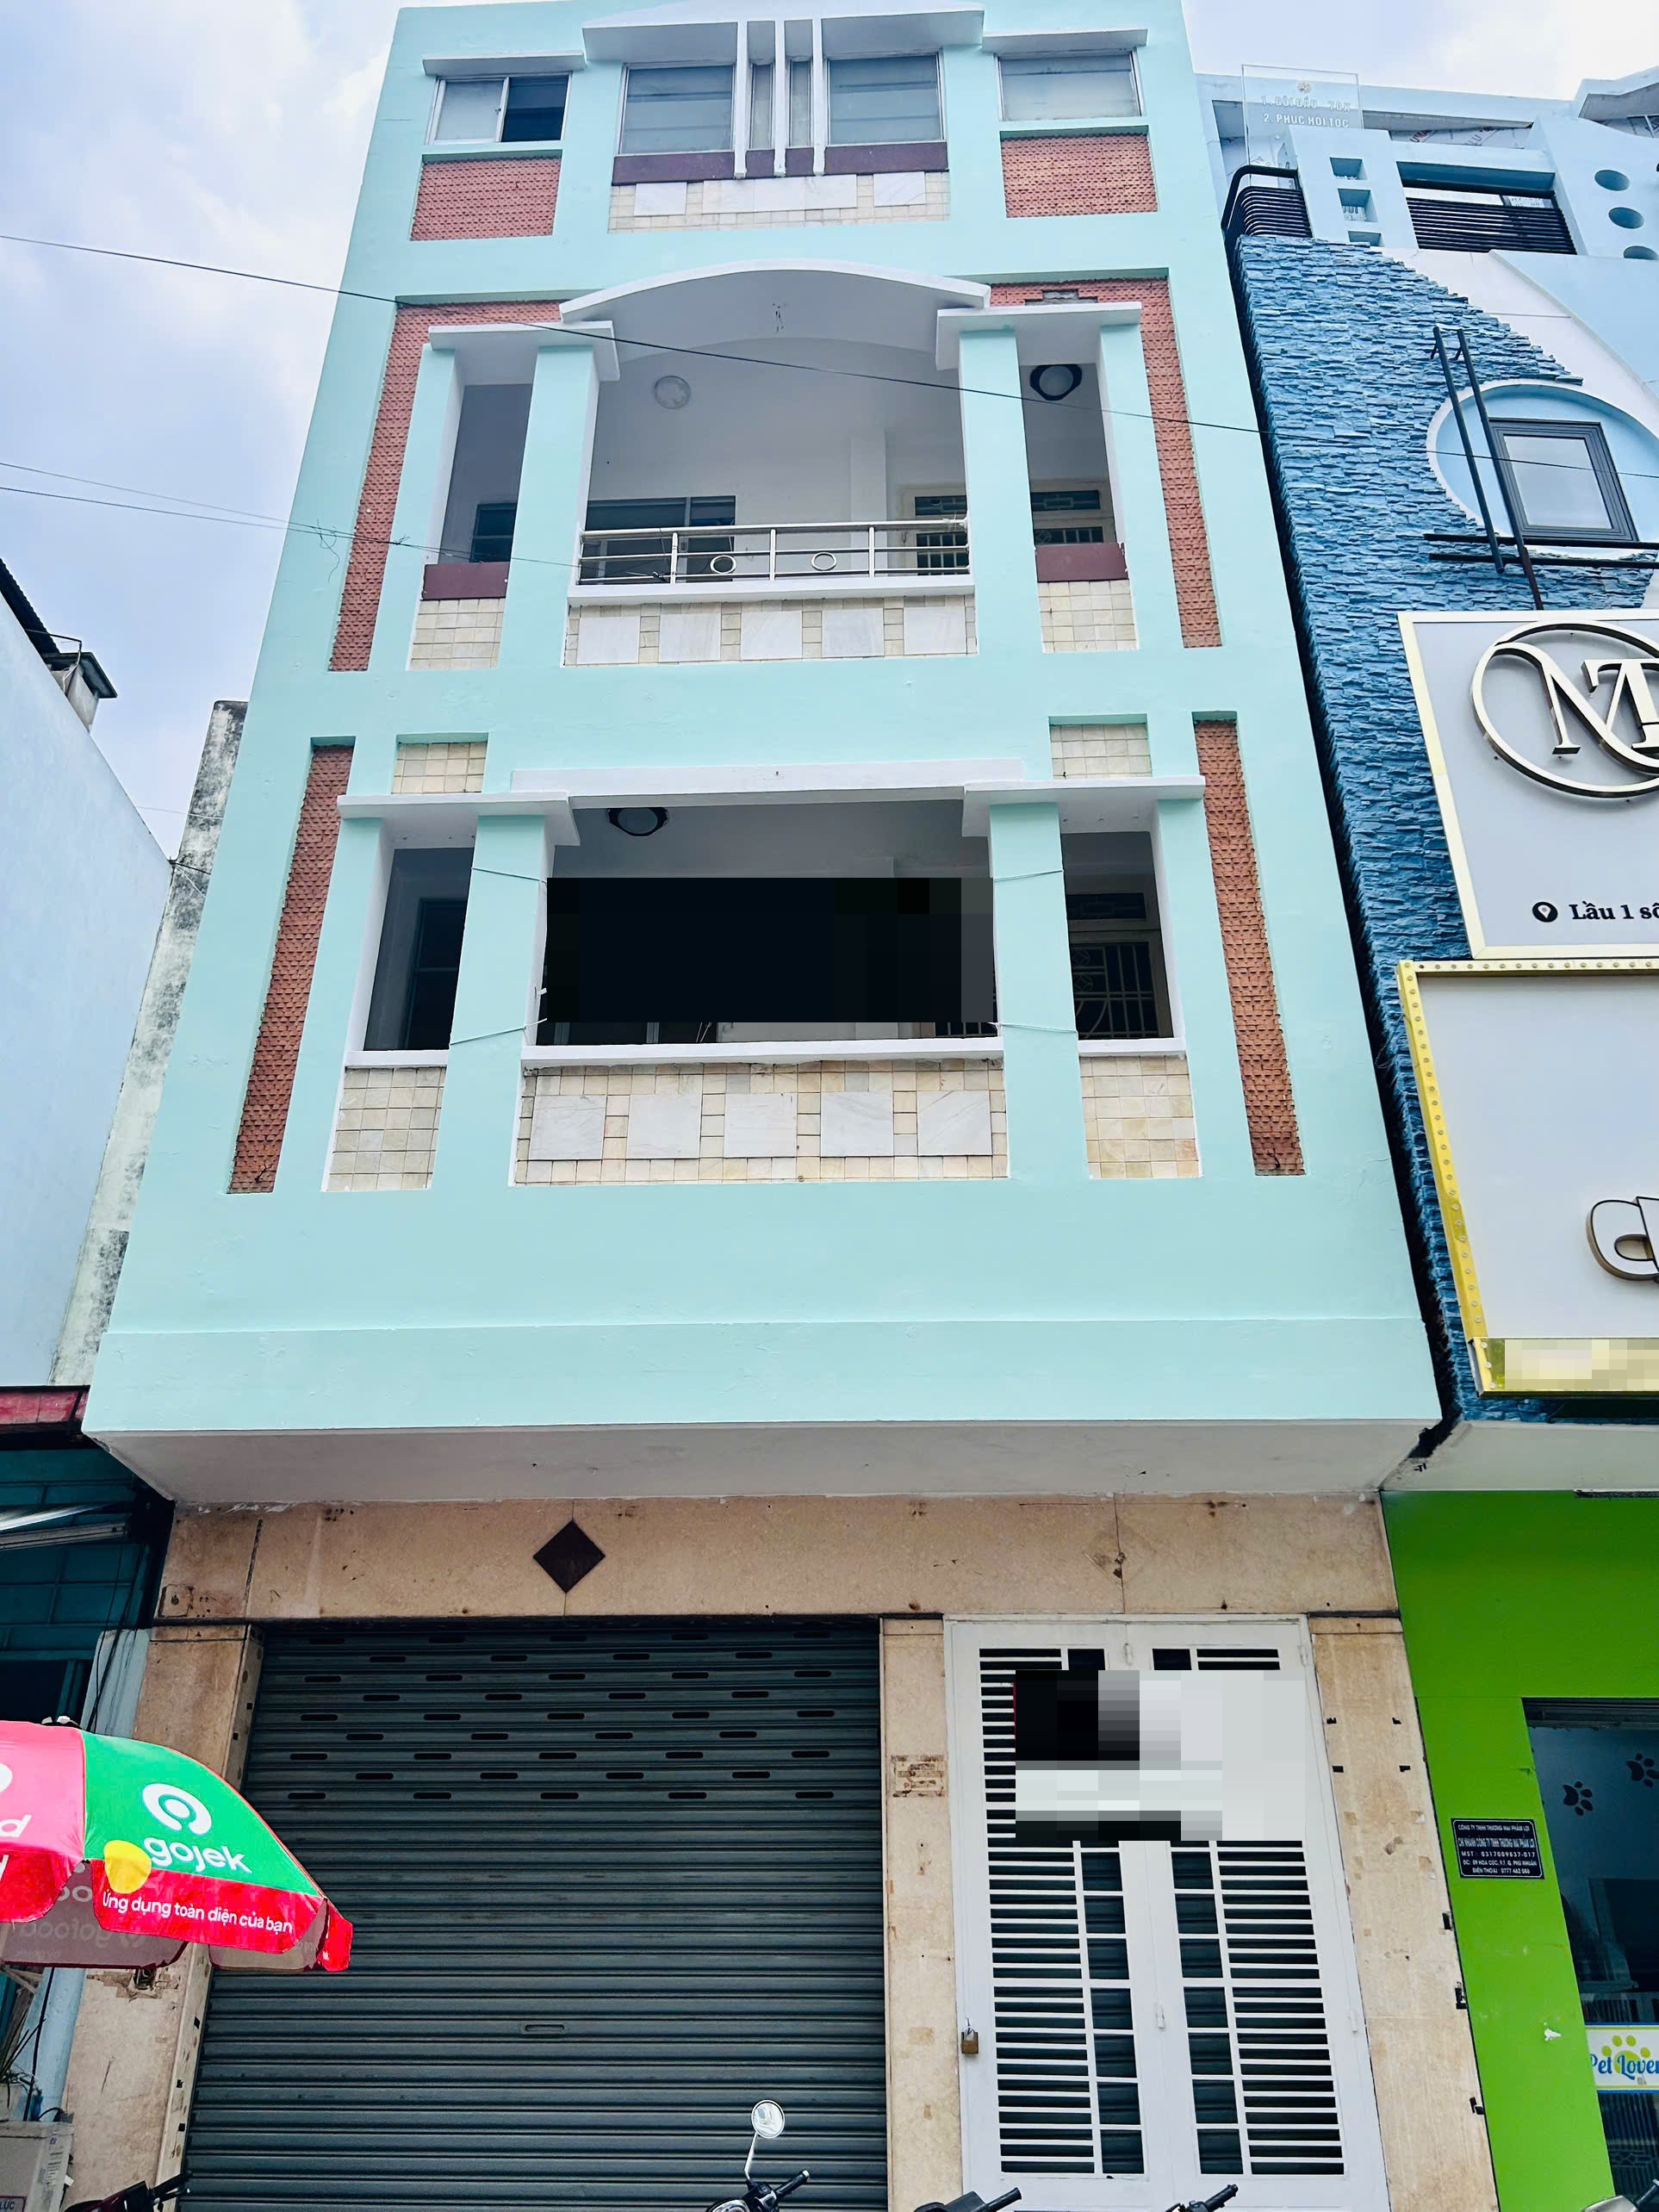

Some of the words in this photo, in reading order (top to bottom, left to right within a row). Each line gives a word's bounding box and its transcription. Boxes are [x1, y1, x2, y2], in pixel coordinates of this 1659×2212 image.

[1569, 901, 1616, 920] Lầu
[1620, 904, 1634, 919] 1
[143, 1837, 252, 1873] gojek
[103, 1889, 129, 1913] Ứng
[131, 1897, 171, 1917] dụng
[173, 1902, 205, 1919] toàn
[208, 1907, 238, 1927] diện
[239, 1911, 264, 1928] của
[265, 1916, 293, 1935] bạn
